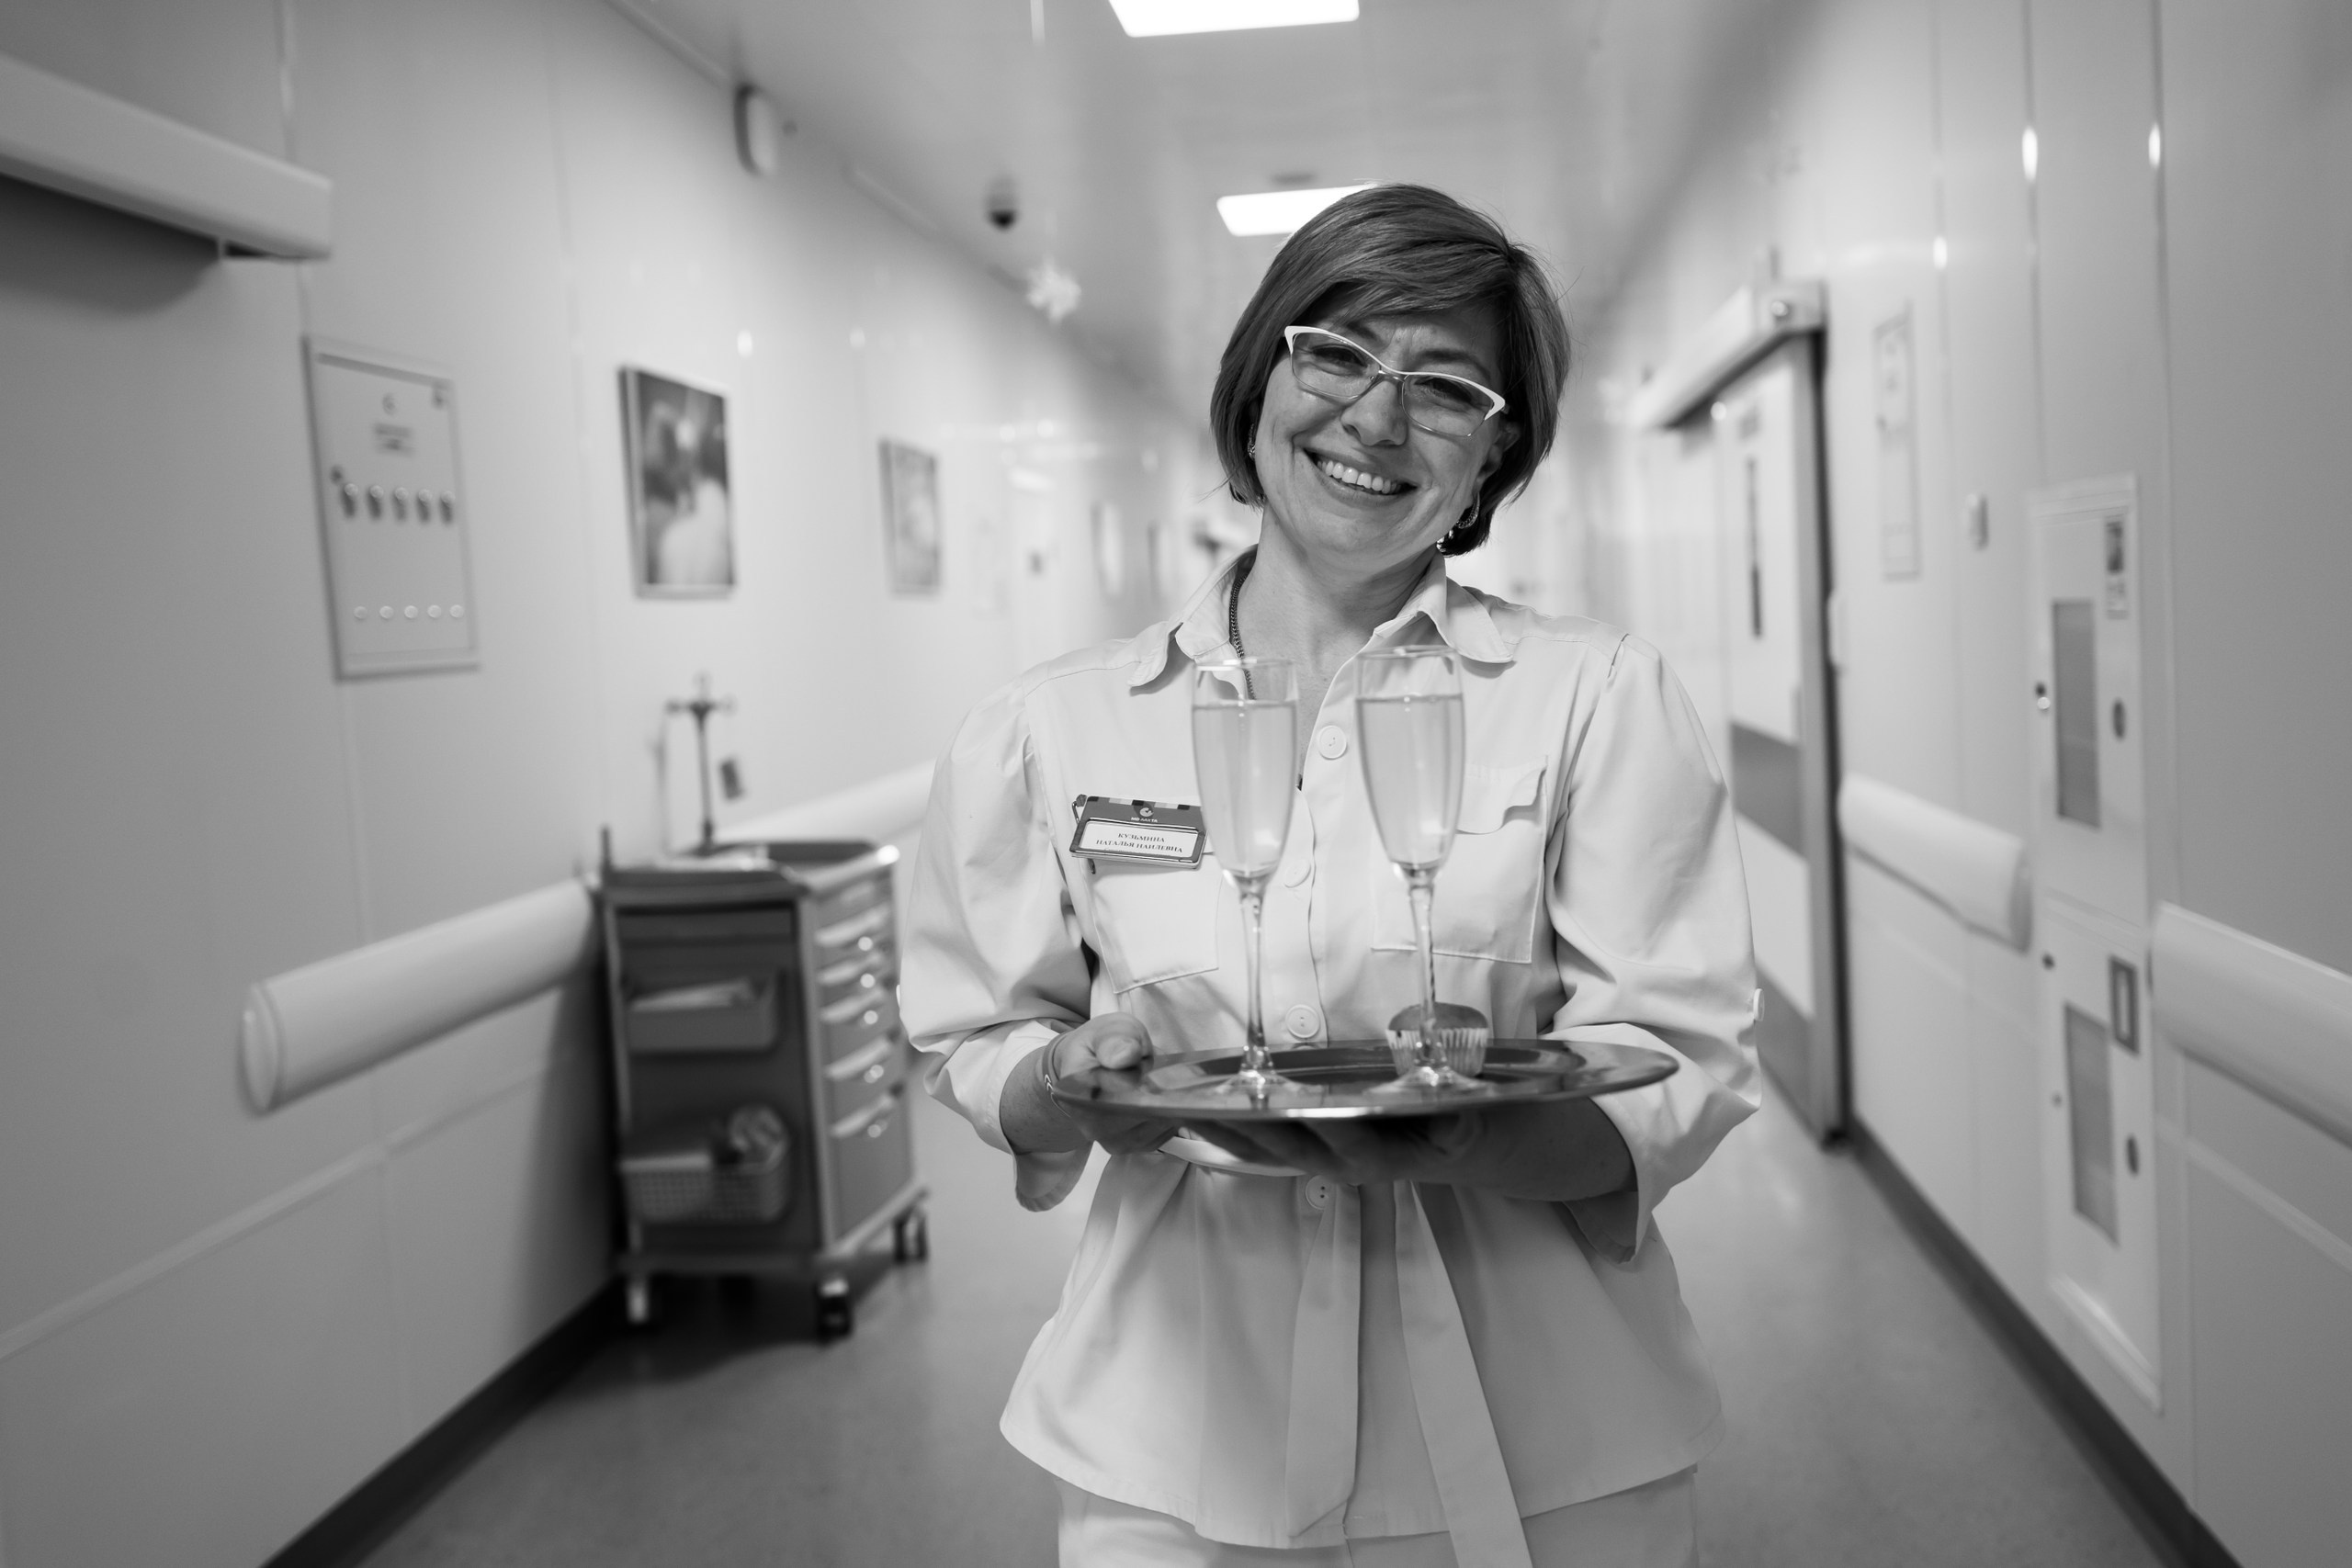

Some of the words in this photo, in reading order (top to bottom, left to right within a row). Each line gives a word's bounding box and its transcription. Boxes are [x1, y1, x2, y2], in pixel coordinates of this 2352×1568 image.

[1118, 833, 1165, 842] КУЗЬМИНА
[1096, 840, 1135, 848] НАТАЛЬЯ
[1136, 843, 1182, 852] НАИЛЕВНА
